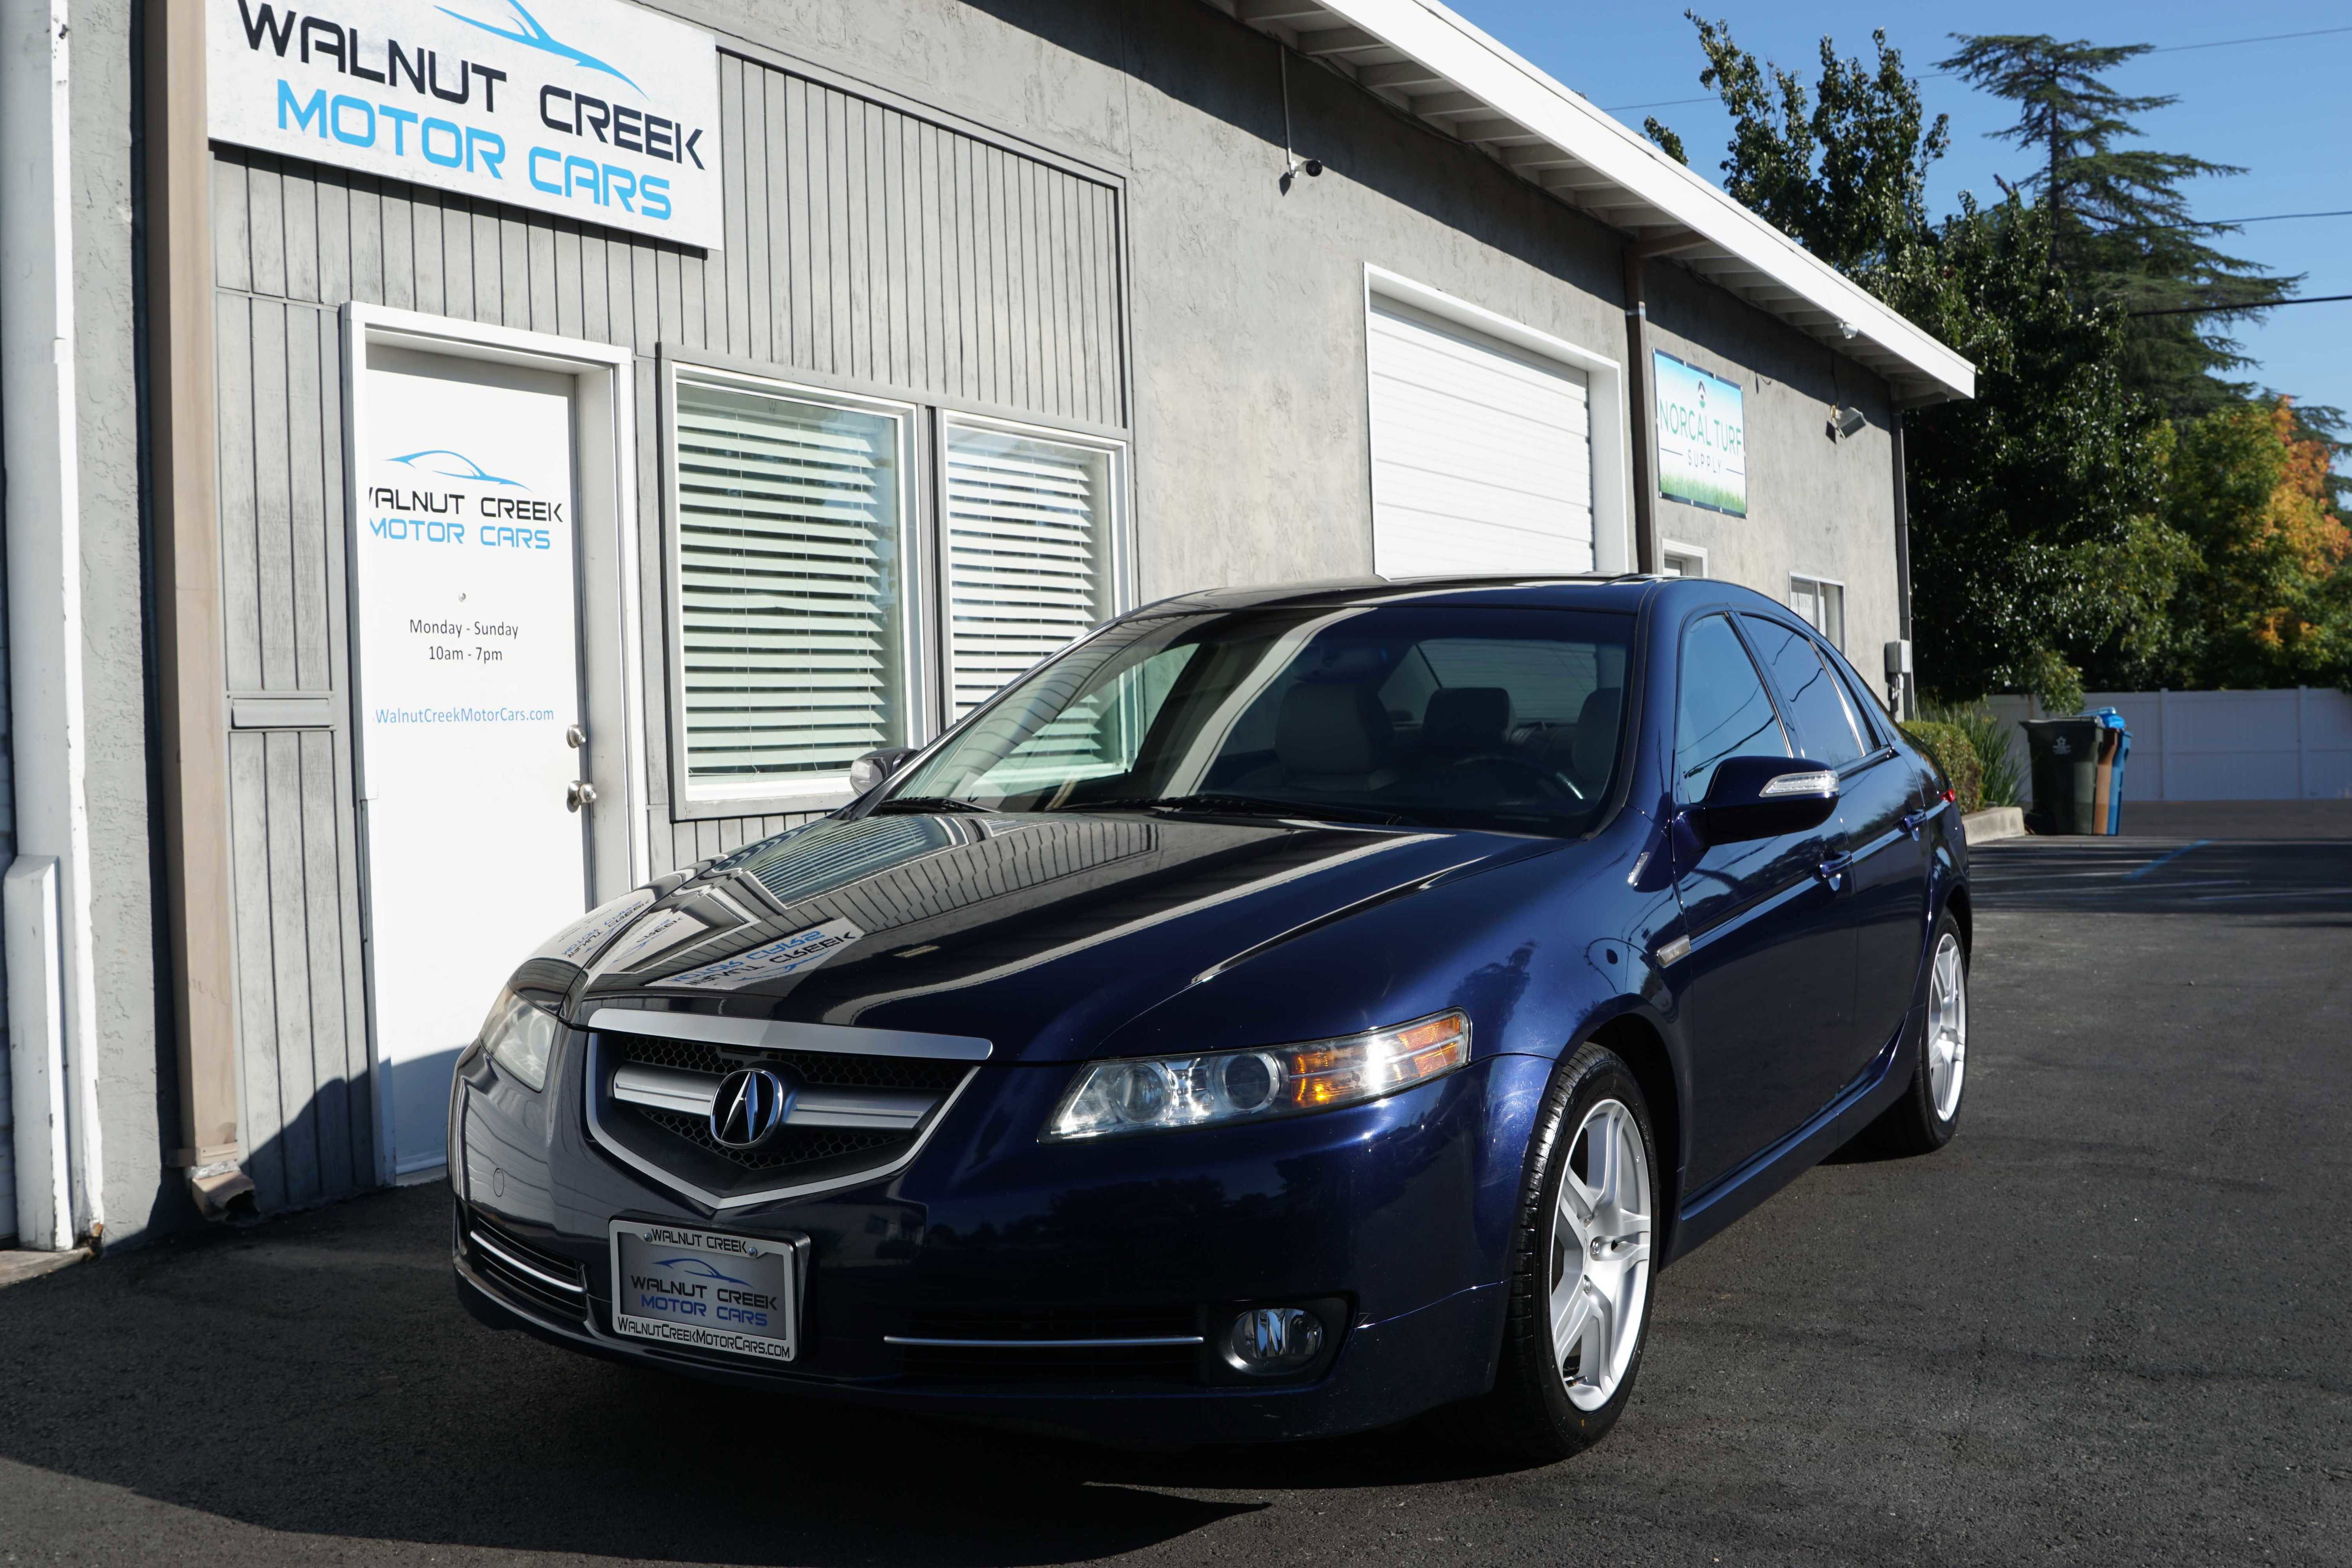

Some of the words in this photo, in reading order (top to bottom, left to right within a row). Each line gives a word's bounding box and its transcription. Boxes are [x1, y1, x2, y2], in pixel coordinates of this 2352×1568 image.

[237, 0, 507, 113] WALNUT
[540, 85, 704, 170] CREEK
[277, 78, 506, 180] MOTOR
[528, 146, 672, 221] CARS
[1659, 398, 1712, 446] NORCAL
[1714, 419, 1742, 455] TURF
[1688, 450, 1722, 474] SUPPLY
[369, 487, 465, 514] ALNUT
[481, 497, 563, 522] CREEK
[369, 517, 465, 544] MOTOR
[480, 525, 550, 550] CARS
[410, 619, 462, 638] Monday
[474, 621, 519, 639] Sunday
[429, 646, 463, 661] 10am
[476, 647, 503, 664] 7pm
[375, 707, 554, 724] WalnutCreekMotorCars.com
[651, 1228, 702, 1247] WALNUT
[706, 1236, 748, 1254] CREEK
[630, 1274, 707, 1298] WALNUT
[717, 1287, 778, 1311] CREEK
[641, 1294, 707, 1317] MOTOR
[716, 1306, 768, 1327] CARS
